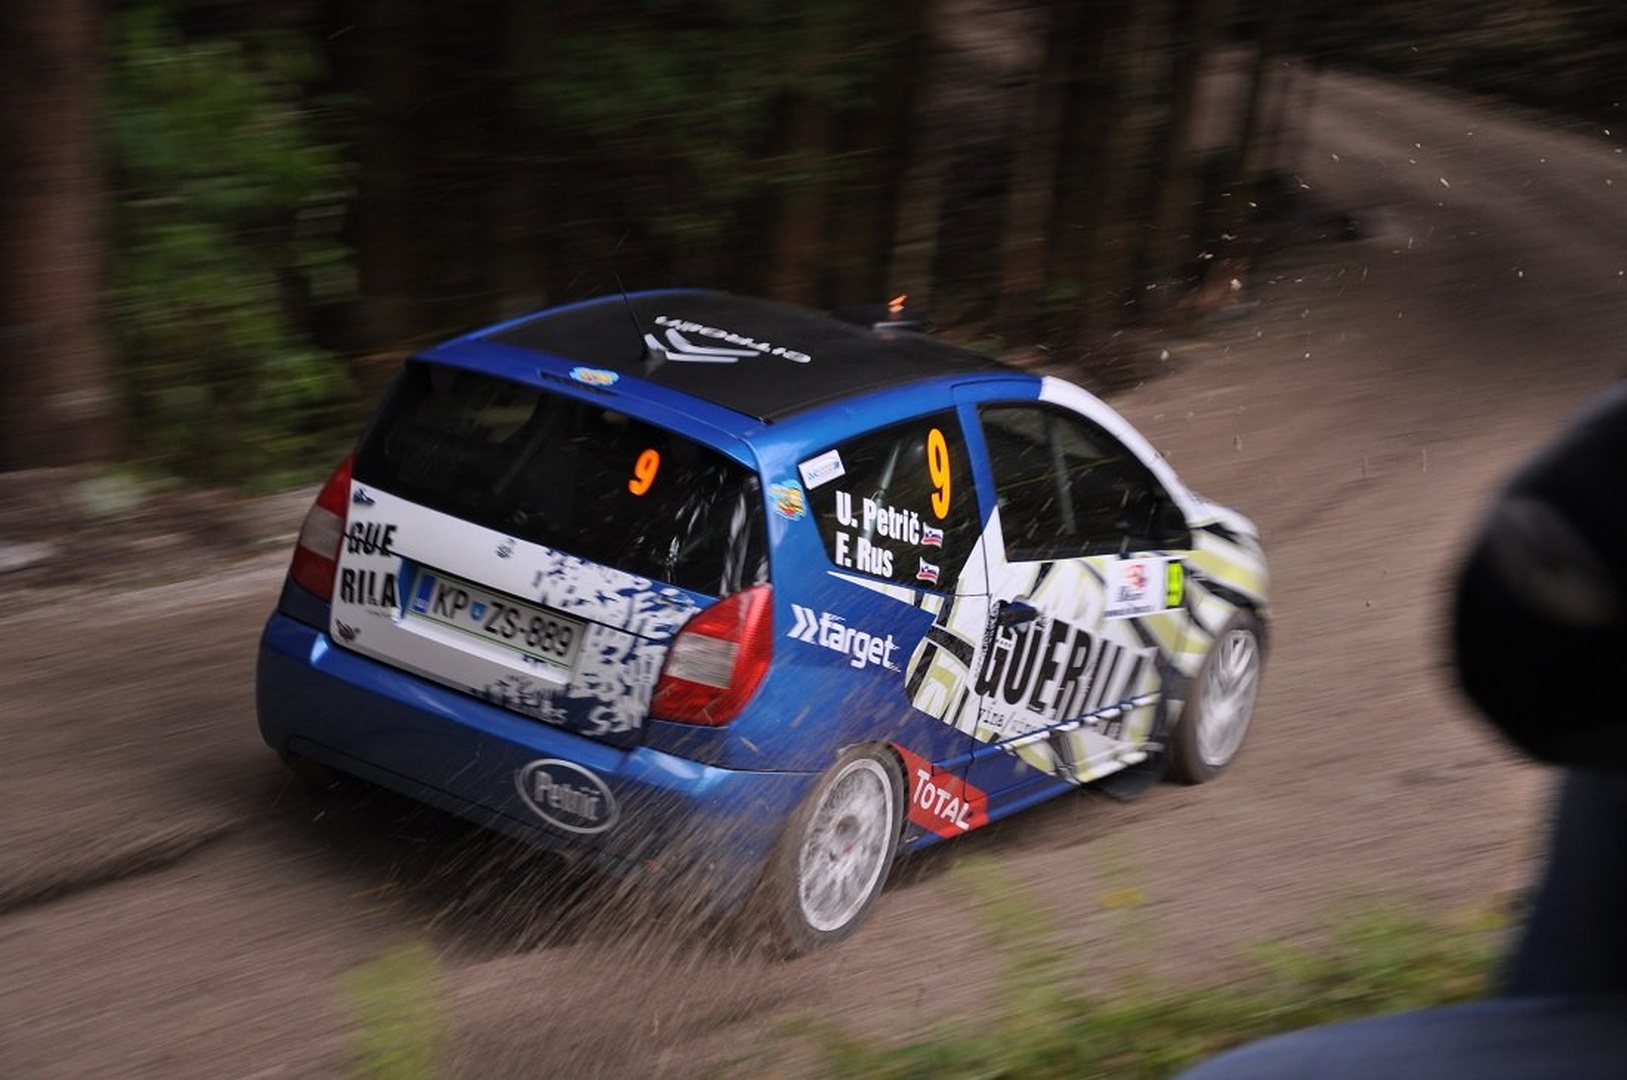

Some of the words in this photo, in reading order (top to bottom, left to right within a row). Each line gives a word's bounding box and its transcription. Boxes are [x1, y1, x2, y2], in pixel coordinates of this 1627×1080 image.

[628, 449, 660, 496] 9
[927, 428, 950, 519] 9
[348, 521, 397, 558] GUE
[835, 491, 858, 528] U.
[863, 498, 920, 545] Petrič
[835, 531, 852, 567] F.
[856, 537, 894, 578] Rus
[433, 583, 470, 619] KP
[484, 601, 574, 656] ZS-889
[818, 613, 896, 669] target
[913, 768, 970, 831] TOTAL
